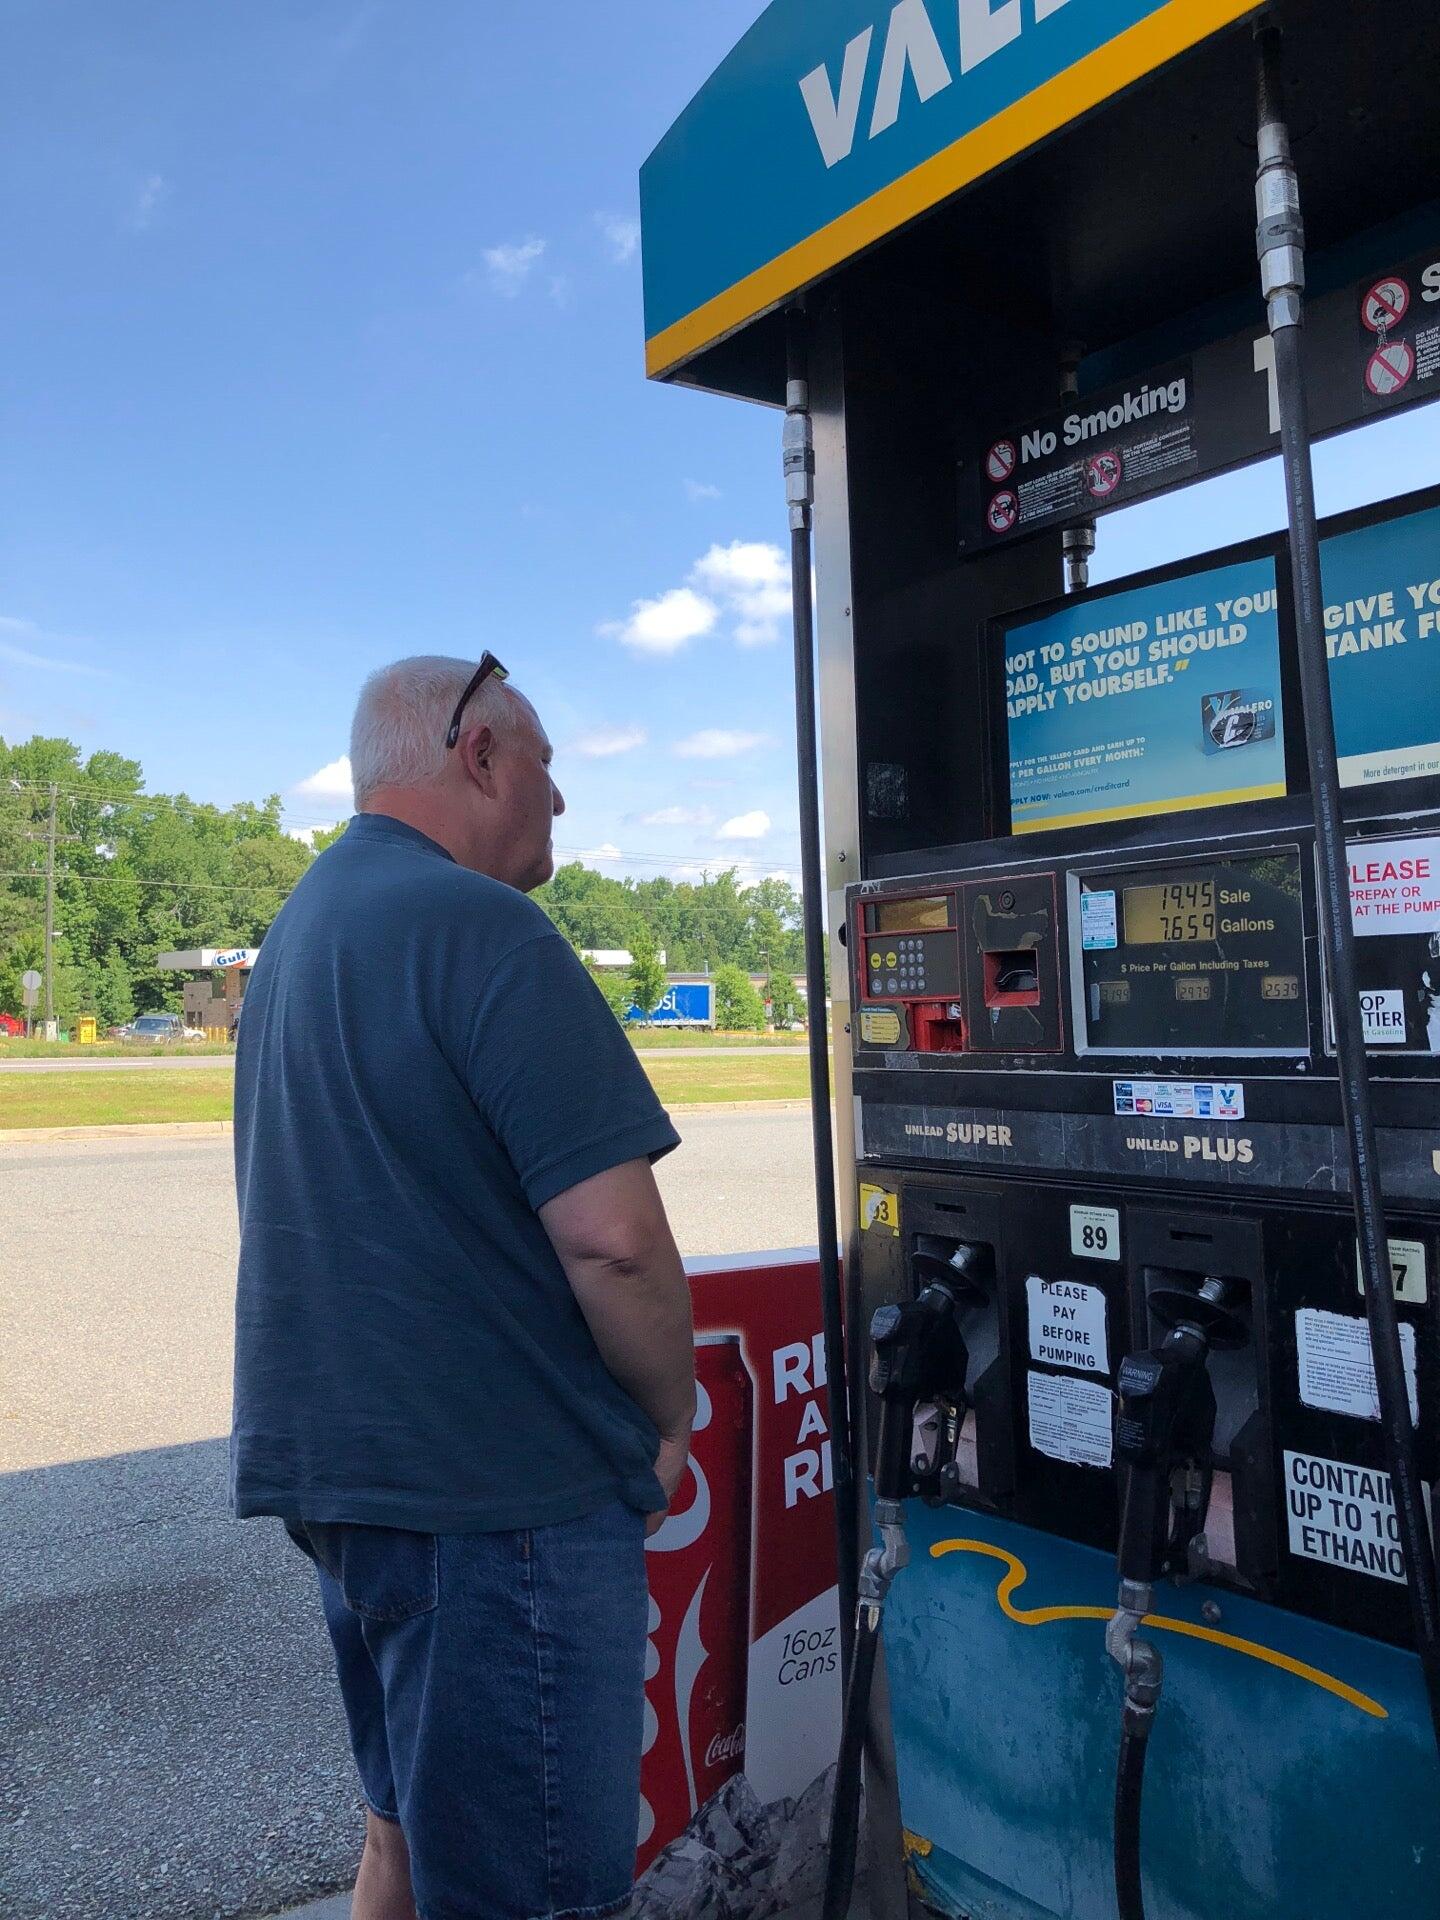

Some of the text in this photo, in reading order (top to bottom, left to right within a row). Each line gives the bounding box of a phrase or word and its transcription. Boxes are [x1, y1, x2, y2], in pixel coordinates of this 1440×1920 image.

[799, 0, 1071, 169] VAL
[1021, 378, 1186, 464] No Smoking
[1323, 591, 1395, 630] GIVE
[1040, 642, 1065, 665] TO
[1071, 621, 1148, 657] SOUND
[1156, 606, 1208, 635] LIKE
[1325, 618, 1407, 659] TANK
[1050, 660, 1085, 686] BUT
[1092, 646, 1140, 674] YOU
[1148, 623, 1248, 662] SHOULD
[1007, 691, 1056, 719] APPLY
[1025, 758, 1036, 766] FOR
[1050, 751, 1072, 761] VALERO
[1073, 747, 1090, 755] CARD
[1107, 741, 1125, 749] EARN
[1018, 768, 1034, 778] PER
[1037, 761, 1072, 775] GALLON
[1074, 756, 1101, 769] EVERY
[1363, 759, 1440, 779] More detergent in our
[1030, 793, 1051, 804] NOW:
[1053, 779, 1130, 800] valero.com/creditcard
[1350, 858, 1430, 884] LEASE
[1220, 889, 1251, 905] Sale
[1349, 886, 1421, 901] PREPAY OR
[1355, 905, 1370, 916] AT
[1374, 903, 1400, 915] THE
[1220, 917, 1275, 933] Gallons
[217, 950, 248, 967] Gulf
[1129, 963, 1150, 973] Price
[1153, 963, 1167, 972] Per
[1170, 961, 1196, 971] Gallon
[1200, 960, 1239, 971] Including
[1243, 959, 1269, 969] Taxes
[1361, 996, 1385, 1011] OP
[1364, 1011, 1403, 1027] TIER
[1157, 1101, 1172, 1109] VISA
[905, 1122, 1013, 1147] UNLEAD SUPER
[1126, 1135, 1254, 1163] UNLEAD PLUS
[1083, 1225, 1107, 1250] 89
[1392, 1263, 1408, 1291] 7
[1041, 1282, 1088, 1302] PLEASE
[1053, 1305, 1076, 1321] PAY
[1042, 1324, 1090, 1345] BEFORE
[1038, 1345, 1096, 1368] PUMPING
[1290, 1489, 1322, 1520] UP
[1328, 1498, 1362, 1532] TO
[1302, 1525, 1405, 1578] ETHANO
[782, 1627, 836, 1660] 16oz
[778, 1652, 838, 1686] Cans
